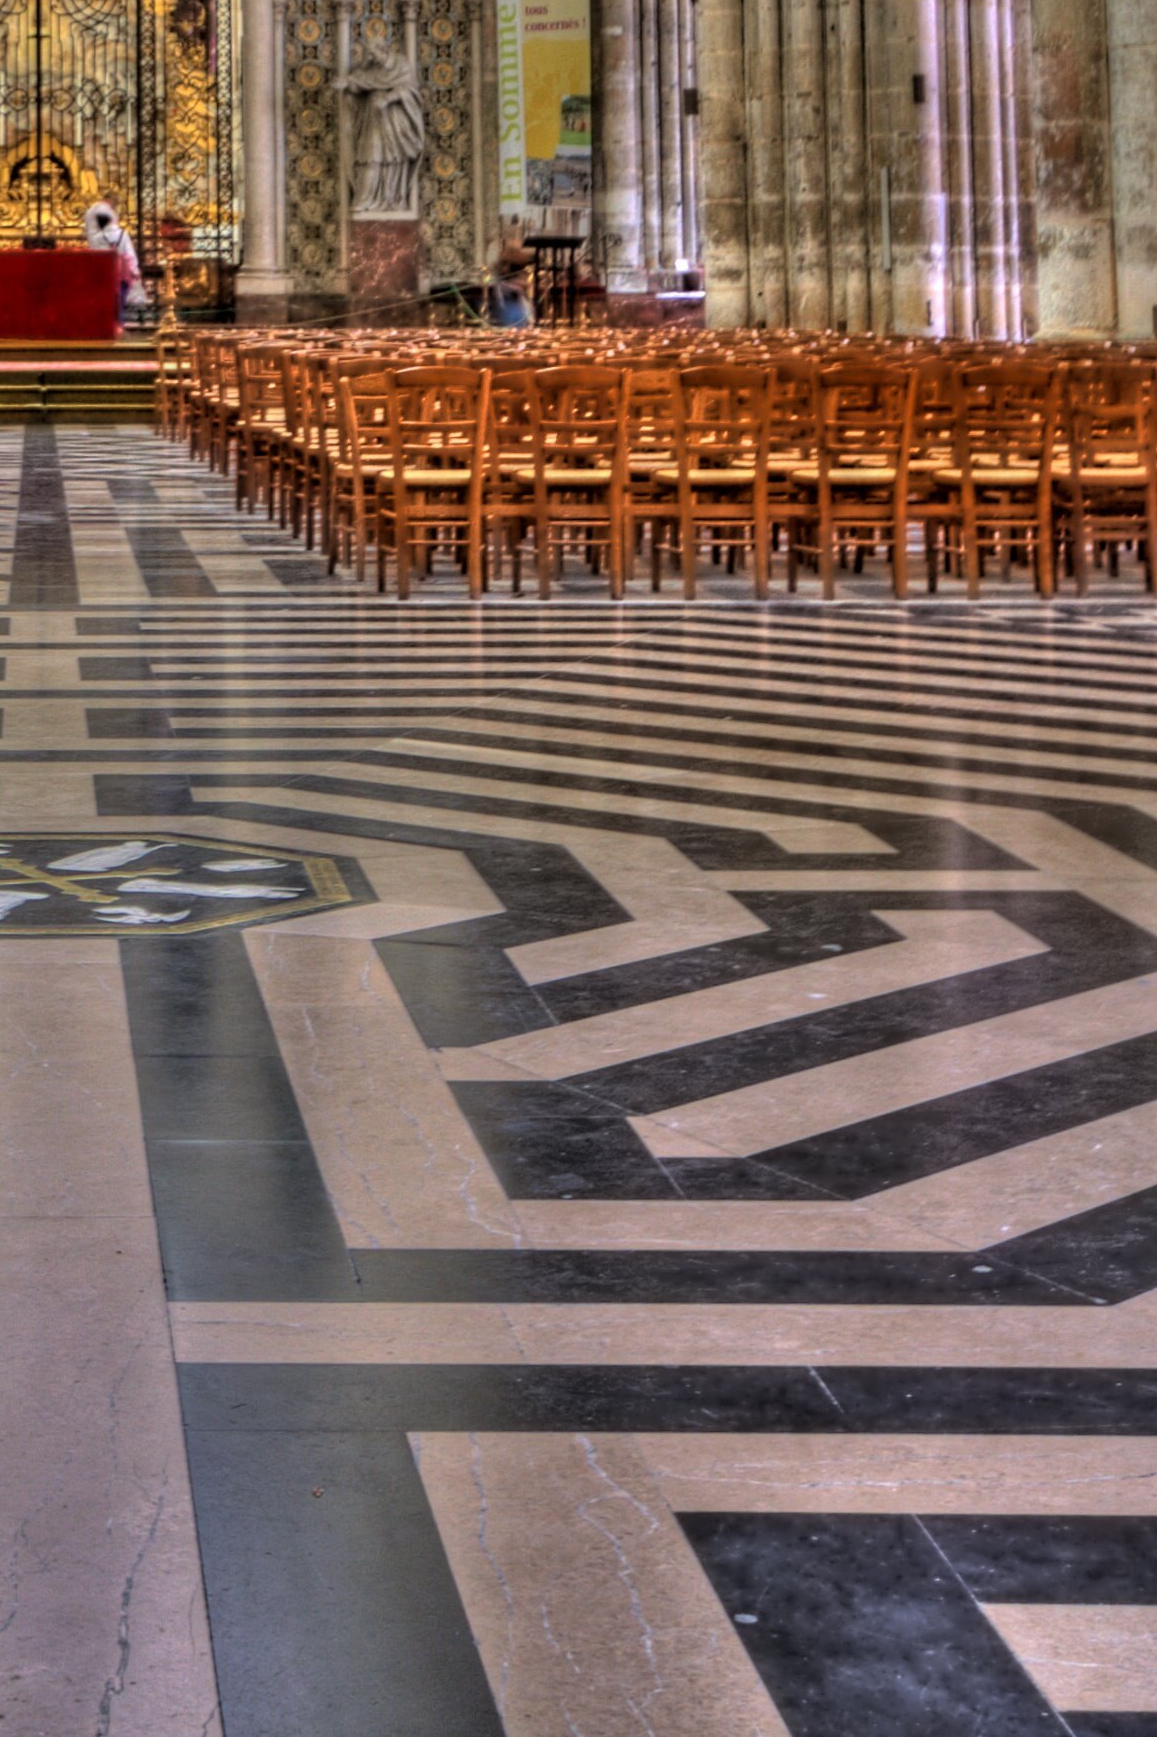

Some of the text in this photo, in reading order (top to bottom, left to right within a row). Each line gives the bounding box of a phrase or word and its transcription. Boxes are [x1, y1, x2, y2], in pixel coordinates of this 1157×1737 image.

[525, 6, 549, 16] tous
[525, 18, 579, 32] concernés
[499, 3, 521, 143] Somme
[500, 154, 523, 201] En
